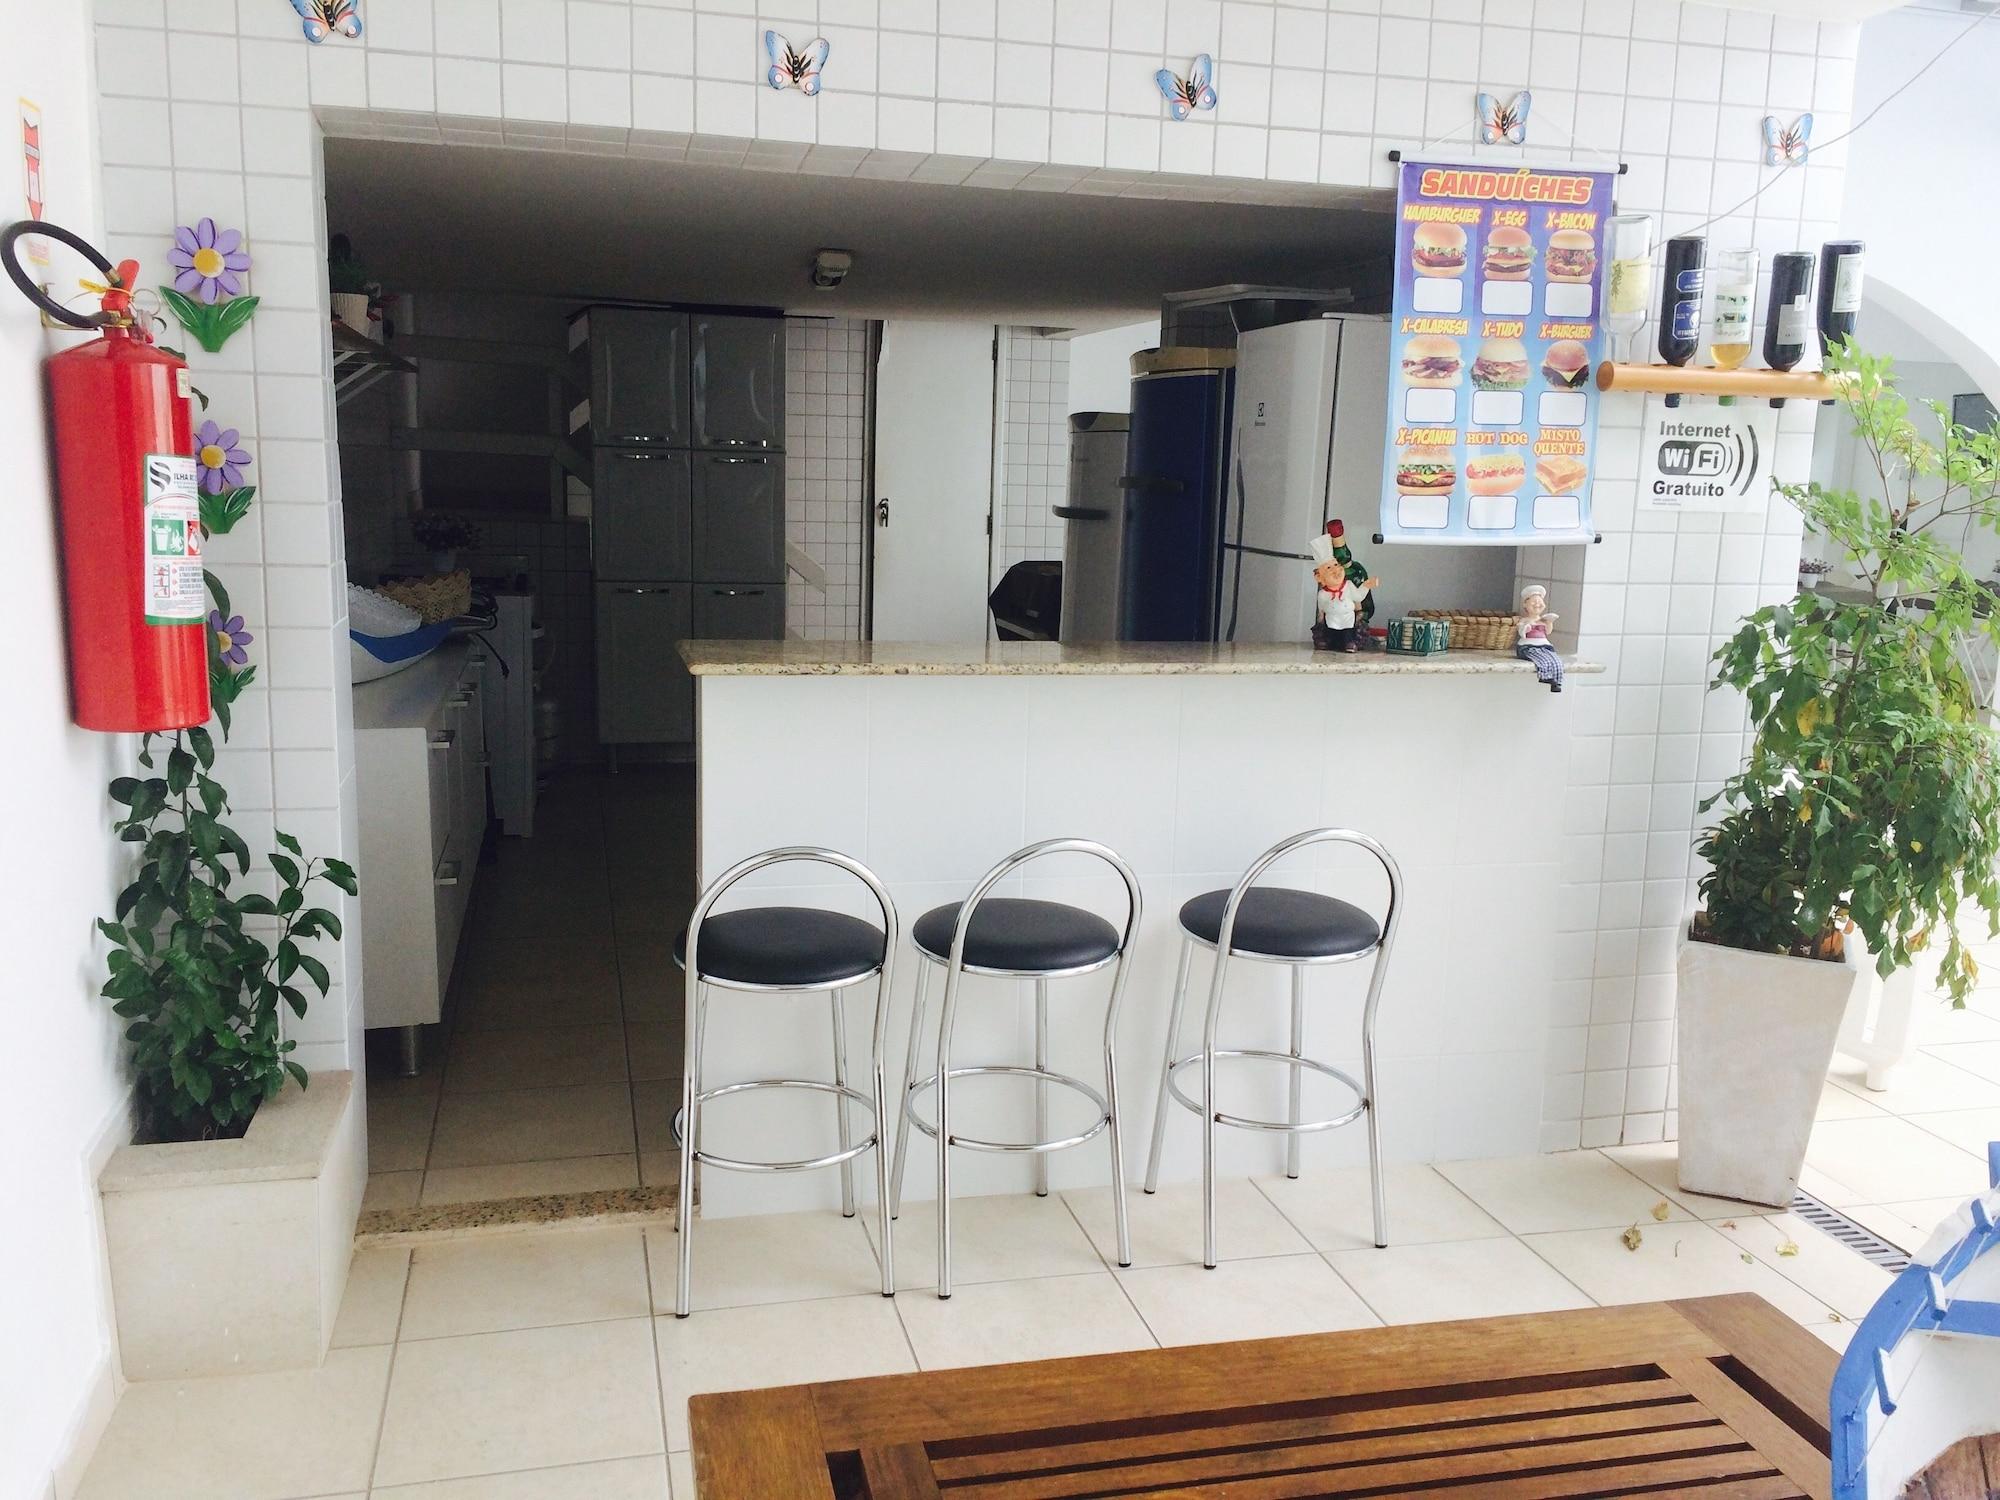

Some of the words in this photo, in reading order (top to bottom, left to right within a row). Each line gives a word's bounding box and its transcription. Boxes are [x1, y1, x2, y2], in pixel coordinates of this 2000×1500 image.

[1421, 168, 1594, 204] SANDUÍCHES
[1403, 205, 1482, 224] HAMBURGUER
[1492, 210, 1527, 226] X-EGG
[1546, 212, 1597, 230] X-BACON
[1401, 318, 1469, 337] X-CALABRESA
[1482, 320, 1524, 338] X-TUDO
[1396, 428, 1458, 446] X-PICANHA
[1540, 428, 1580, 442] MISTO
[1660, 421, 1731, 438] Internet
[1465, 432, 1494, 446] HOT
[1500, 432, 1528, 446] DOG
[1534, 441, 1586, 457] QUENTE
[1652, 480, 1725, 498] Gratuito
